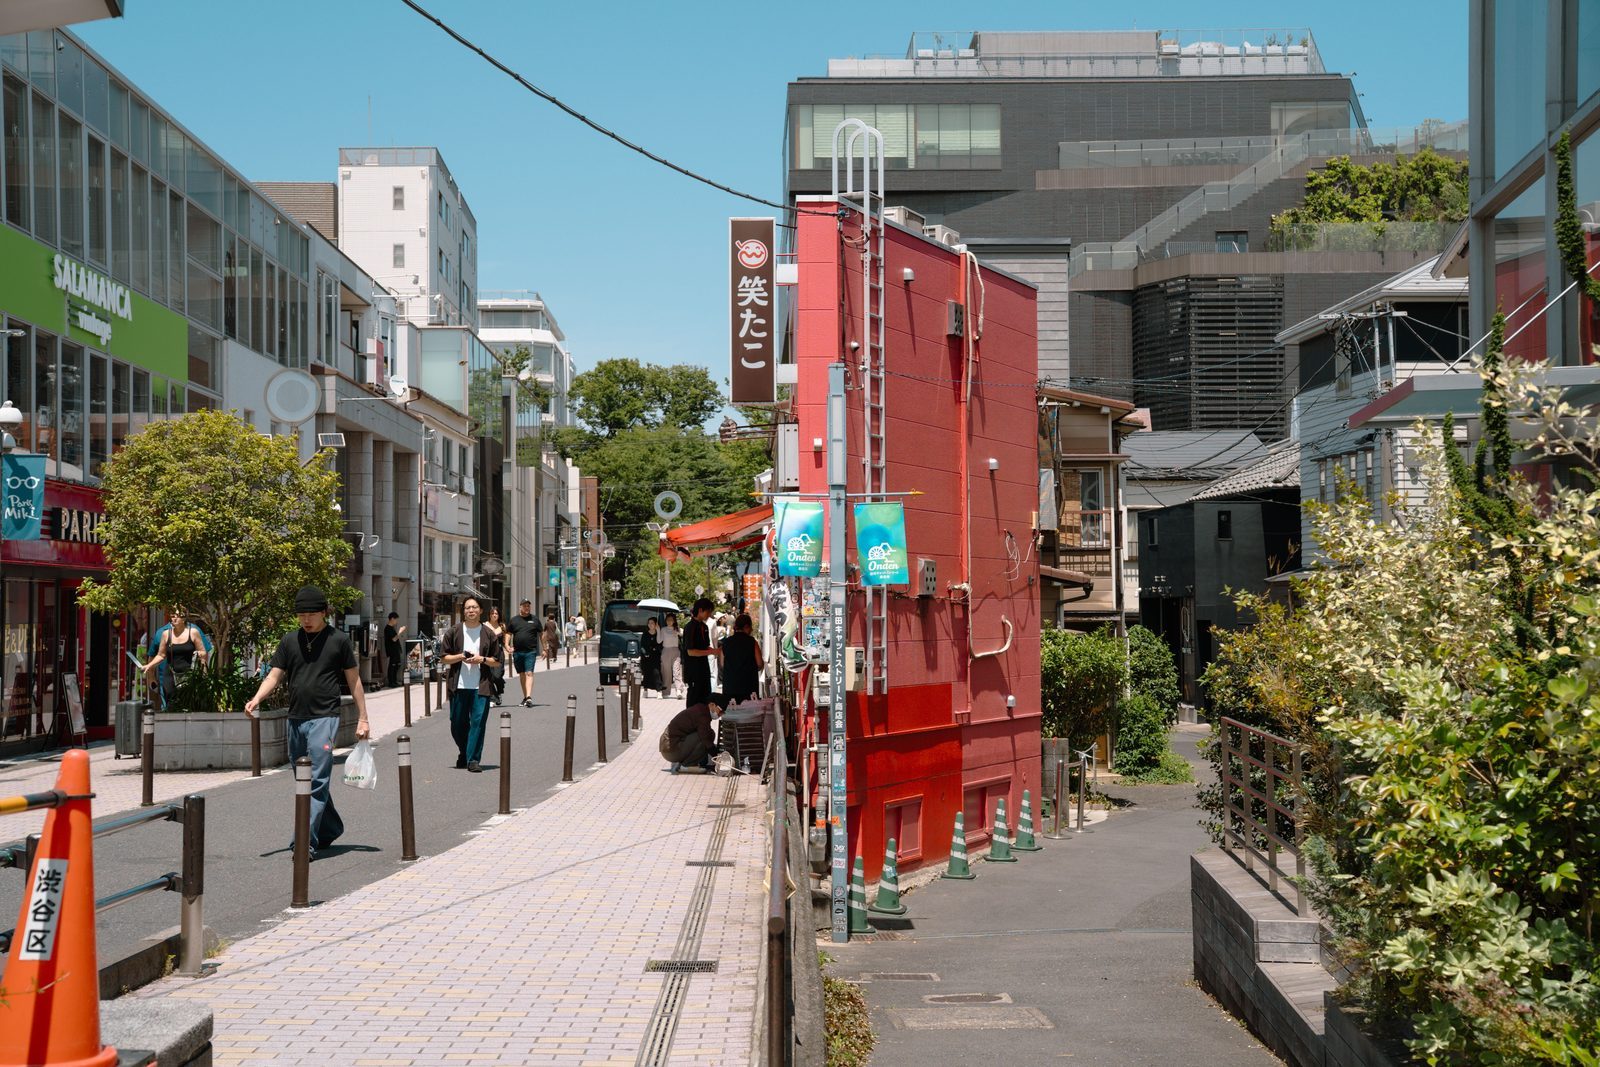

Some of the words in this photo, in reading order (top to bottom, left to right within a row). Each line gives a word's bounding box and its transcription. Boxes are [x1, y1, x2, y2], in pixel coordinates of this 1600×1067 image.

[54, 254, 132, 321] SALAMANCA
[737, 275, 768, 369] 笑たこ
[8, 495, 33, 508] Paris
[5, 506, 39, 520] Miki
[787, 551, 816, 562] Onden
[868, 561, 899, 571] Onden
[26, 869, 61, 953] 渋谷区
